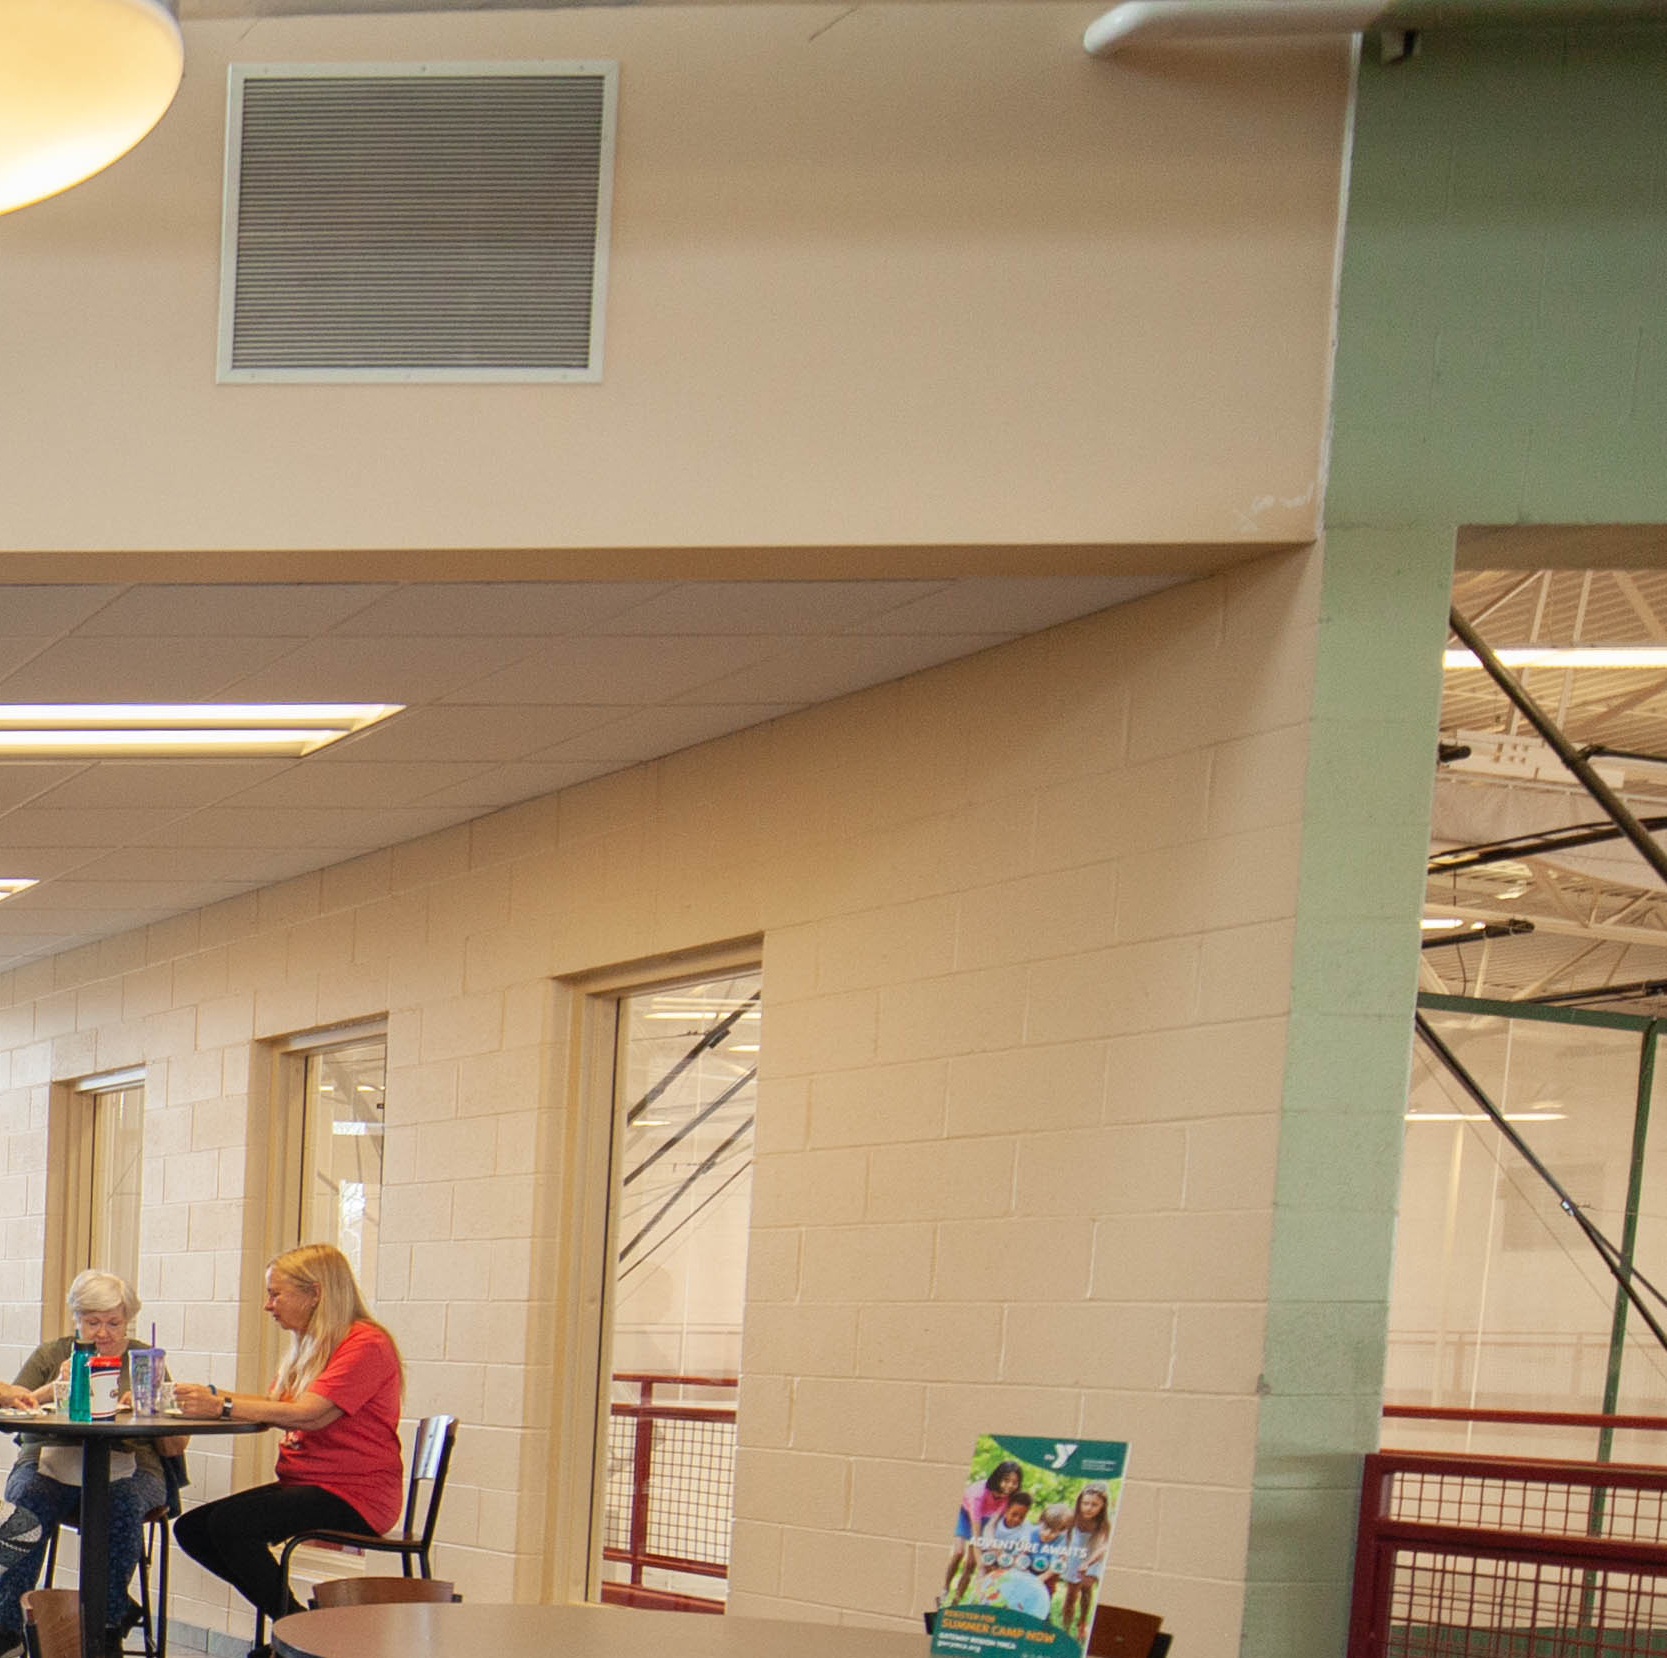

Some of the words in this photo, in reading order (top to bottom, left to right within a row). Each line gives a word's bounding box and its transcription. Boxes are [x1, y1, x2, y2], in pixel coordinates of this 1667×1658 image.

[1051, 1443, 1078, 1469] Y
[968, 1536, 1039, 1554] ADVENTURE
[1041, 1543, 1088, 1559] AWAITS
[941, 1618, 990, 1633] SUMMER
[991, 1624, 1025, 1638] CAMP
[1026, 1630, 1056, 1644] NOW
